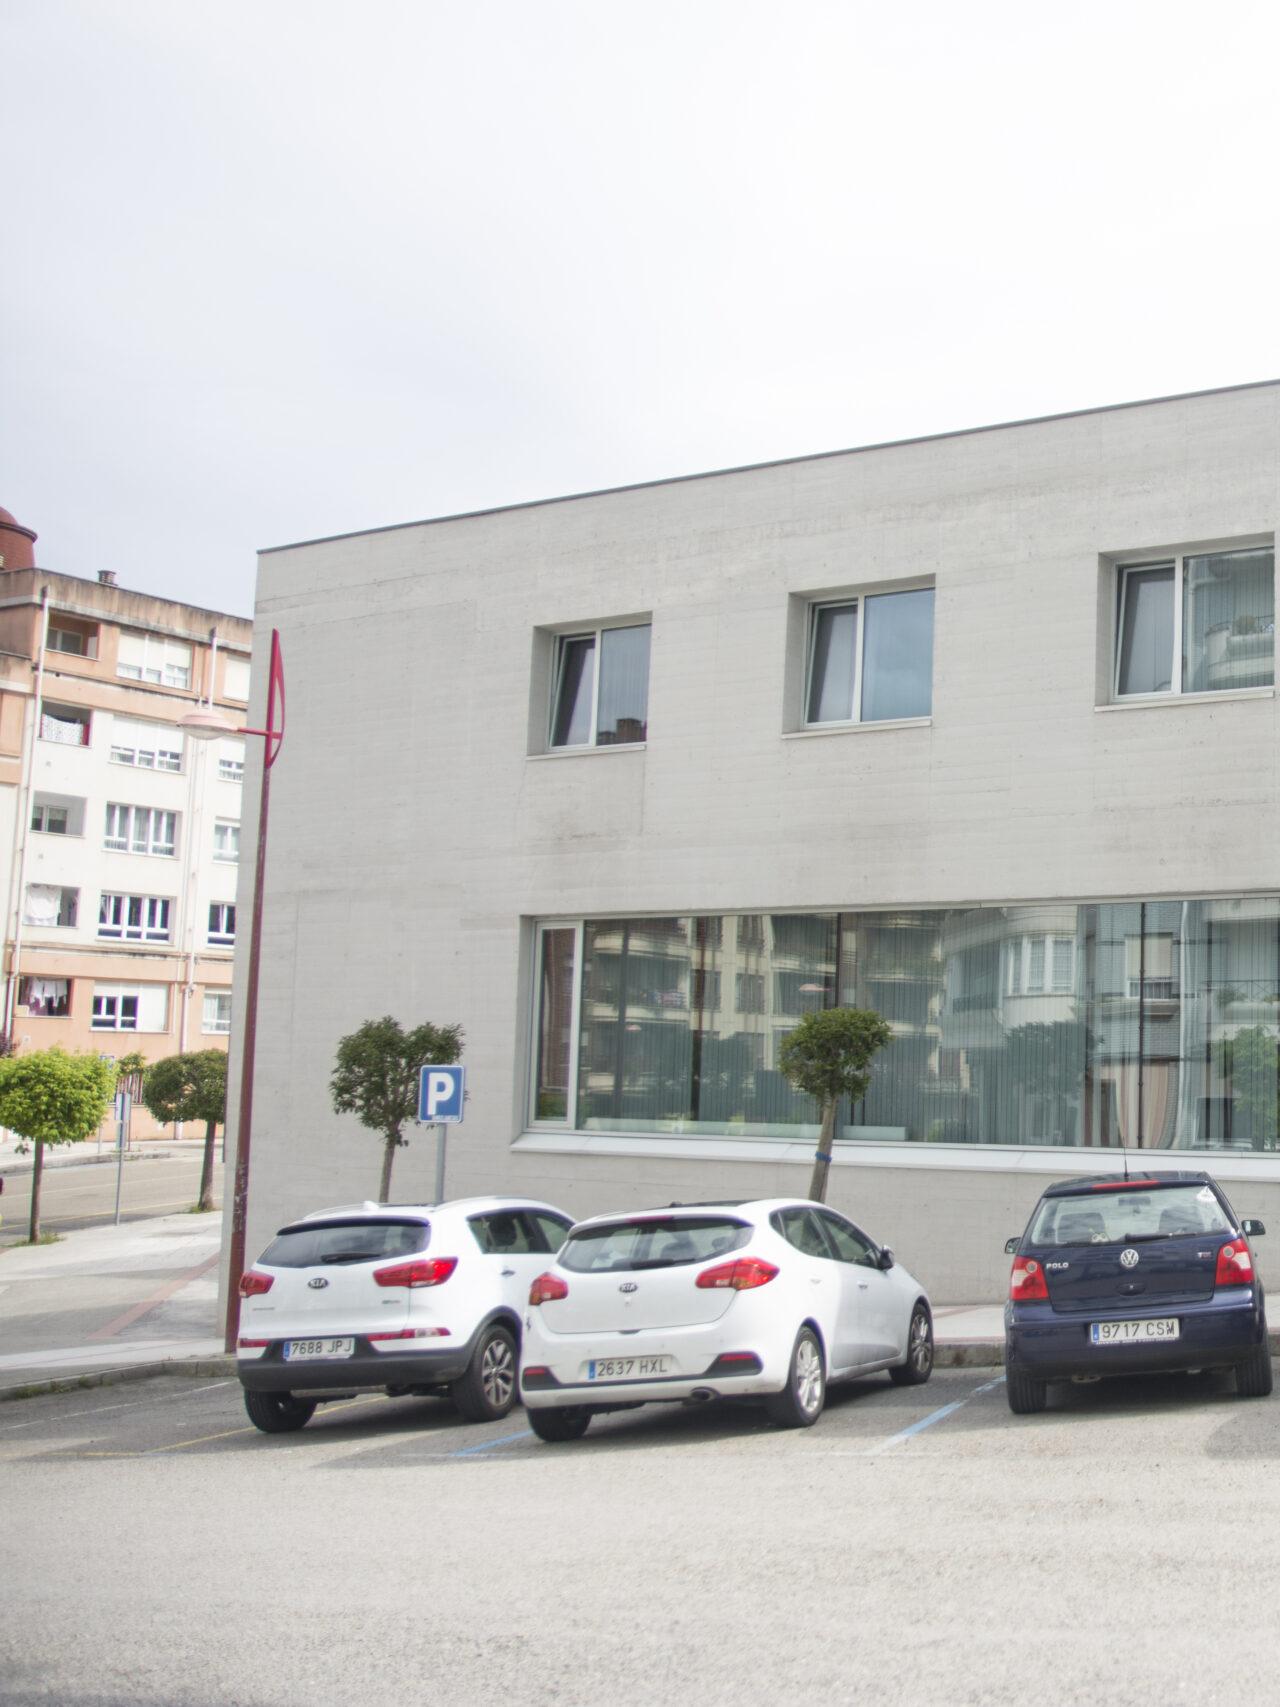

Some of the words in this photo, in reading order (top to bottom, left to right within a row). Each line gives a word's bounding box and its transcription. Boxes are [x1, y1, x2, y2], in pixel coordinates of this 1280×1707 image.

[427, 1072, 455, 1116] P
[1102, 1323, 1140, 1339] 9717
[1146, 1321, 1175, 1336] CSM
[292, 1341, 322, 1355] 7688
[328, 1339, 352, 1353] JPJ
[597, 1360, 634, 1377] 2637
[639, 1358, 668, 1374] HXL
